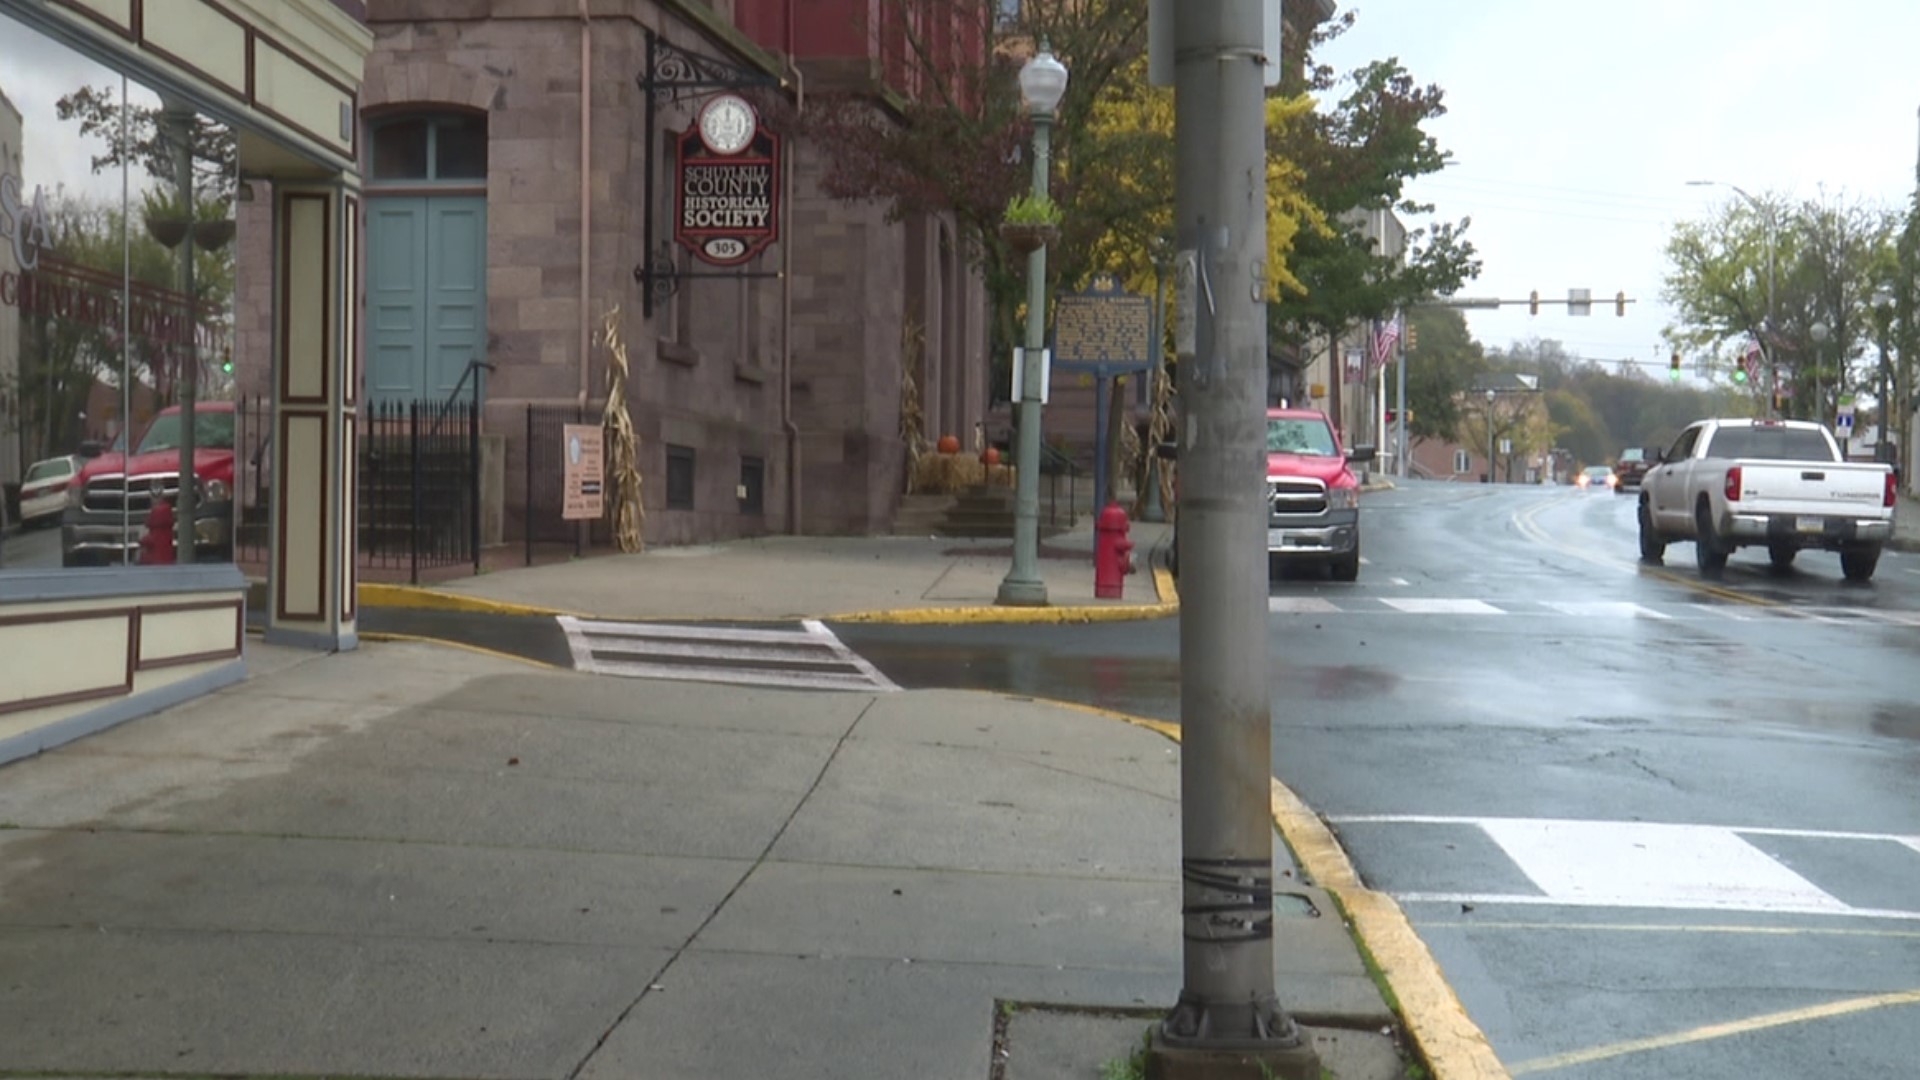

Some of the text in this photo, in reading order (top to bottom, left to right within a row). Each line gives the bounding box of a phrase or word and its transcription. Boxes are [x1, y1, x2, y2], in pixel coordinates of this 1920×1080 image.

[684, 167, 769, 179] SCHUYLKILL
[684, 178, 769, 195] COUNTY
[684, 196, 770, 209] HISTORICAL
[684, 209, 769, 227] SOCIETY
[714, 242, 737, 253] 305
